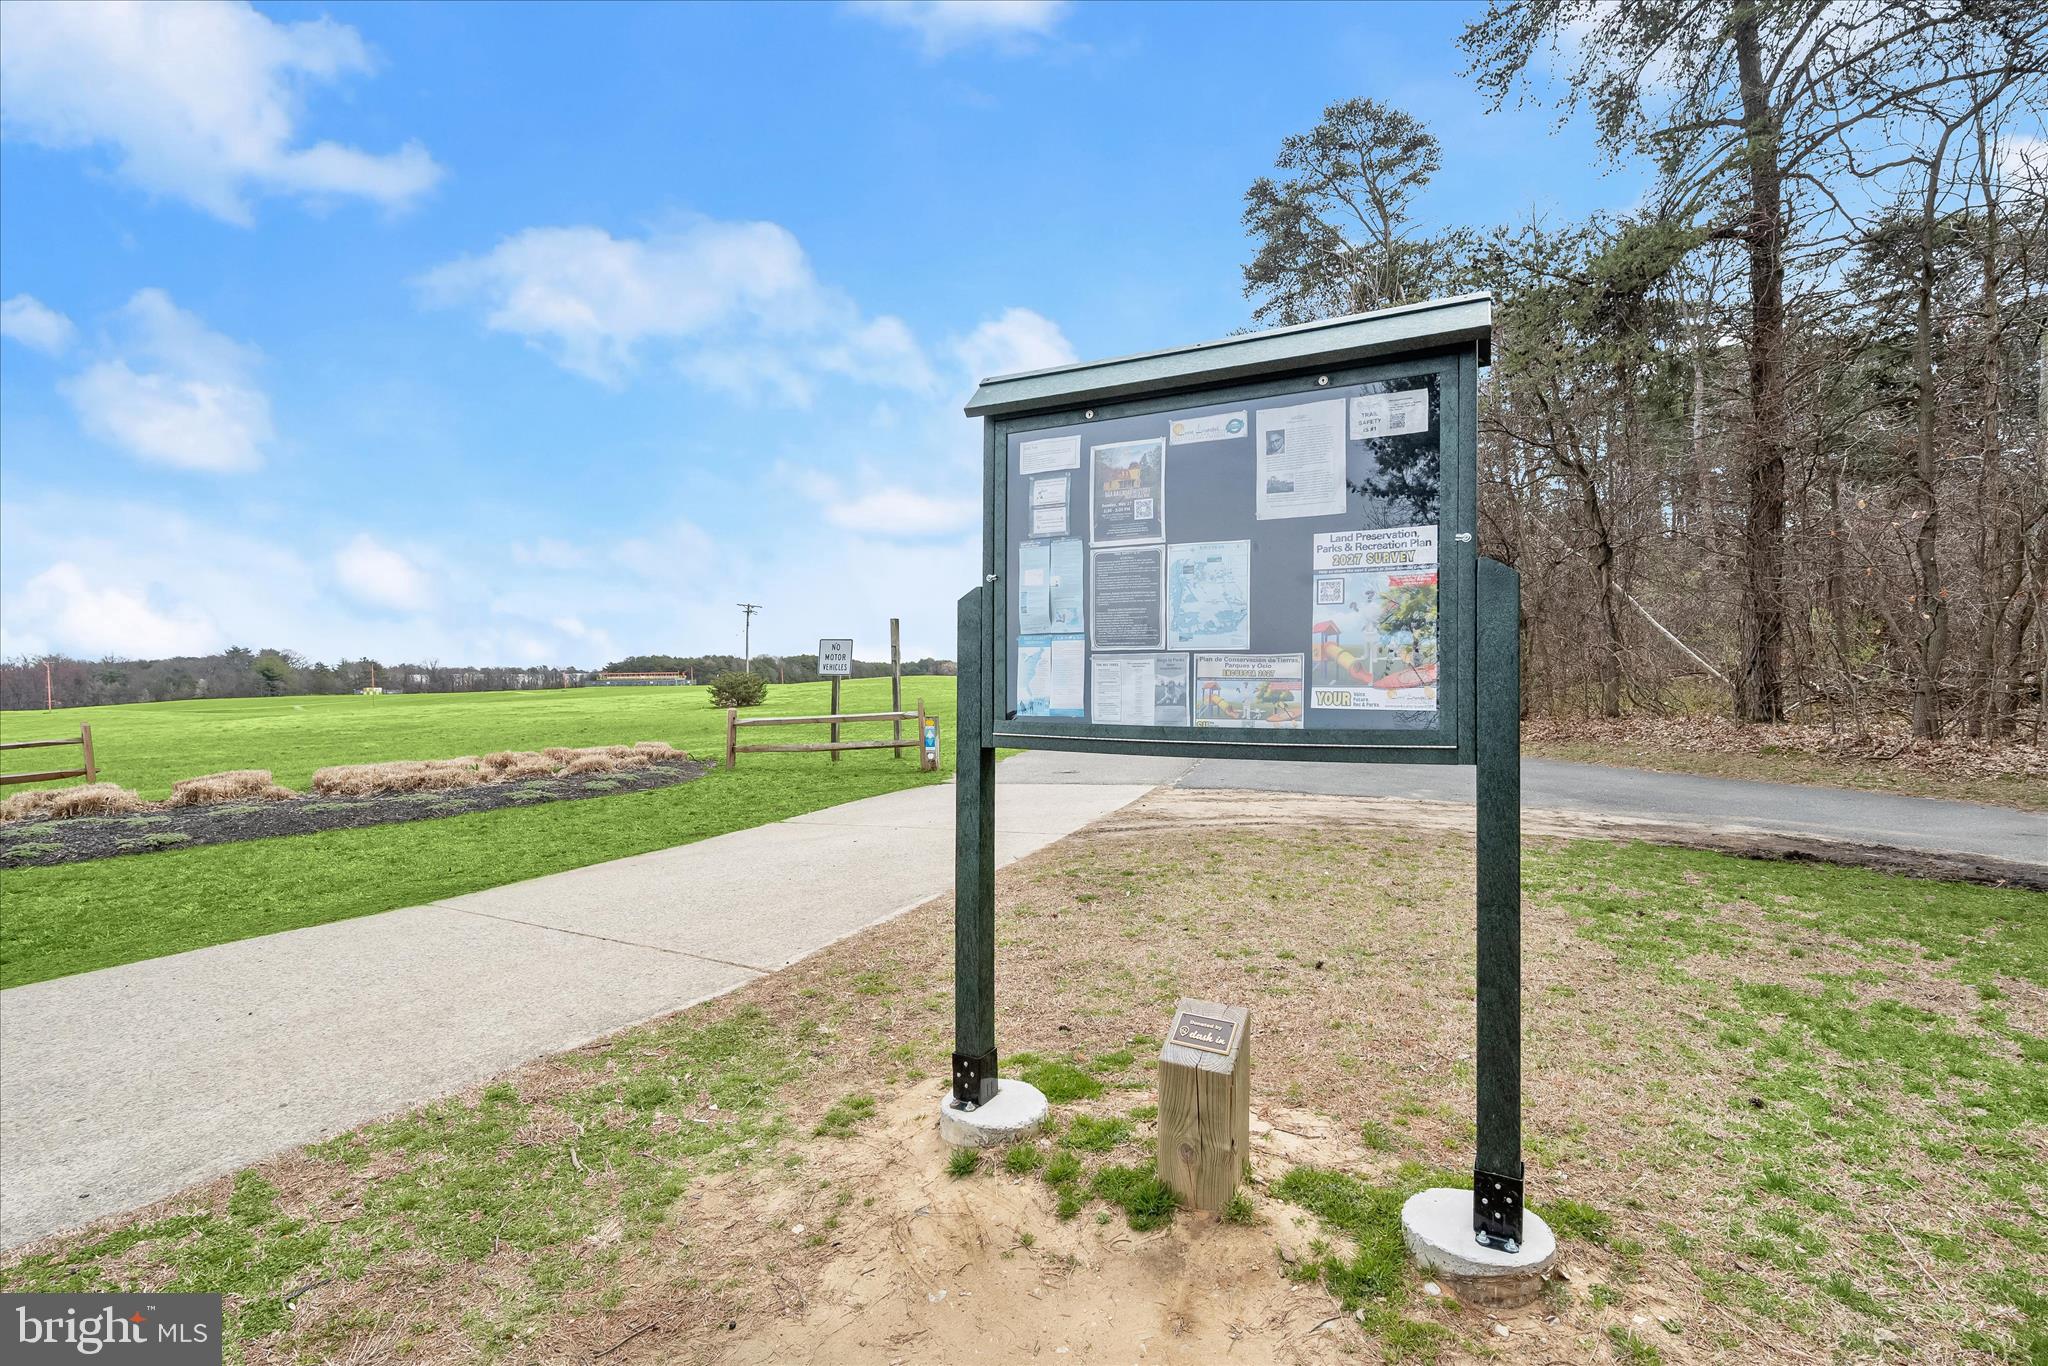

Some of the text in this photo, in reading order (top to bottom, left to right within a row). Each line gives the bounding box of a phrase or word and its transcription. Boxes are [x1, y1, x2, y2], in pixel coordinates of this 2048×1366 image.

[1330, 529, 1420, 543] Land Preservation,
[1316, 538, 1432, 554] Parks & Recreation Plan
[1332, 550, 1416, 566] 2027 SURVEY
[831, 643, 841, 651] NO
[1316, 690, 1352, 706] YOUR
[1190, 1020, 1214, 1029] Donated
[1189, 1030, 1226, 1045] dash in
